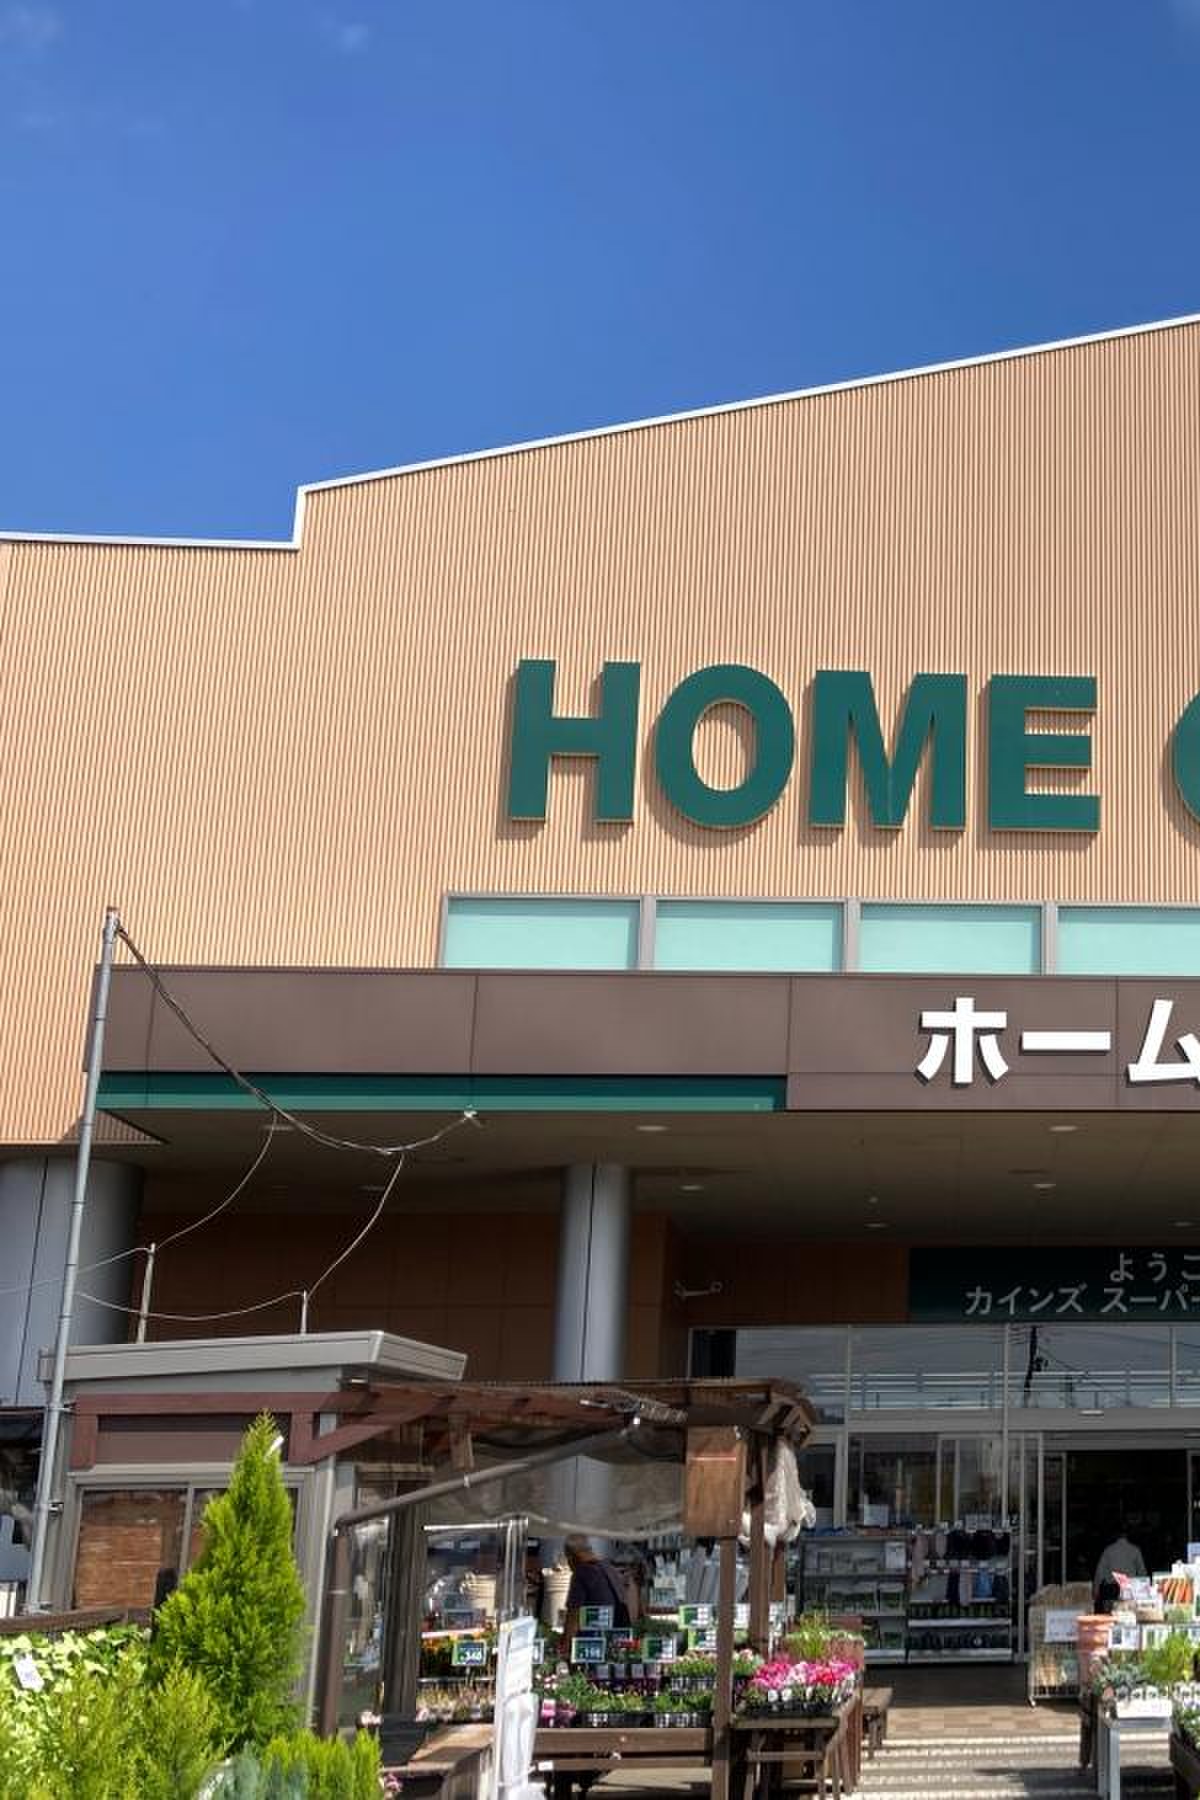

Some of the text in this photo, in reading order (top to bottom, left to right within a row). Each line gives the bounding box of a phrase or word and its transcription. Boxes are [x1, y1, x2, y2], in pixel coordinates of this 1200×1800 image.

[507, 659, 1101, 832] HOME
[965, 1284, 1088, 1315] カインズ
